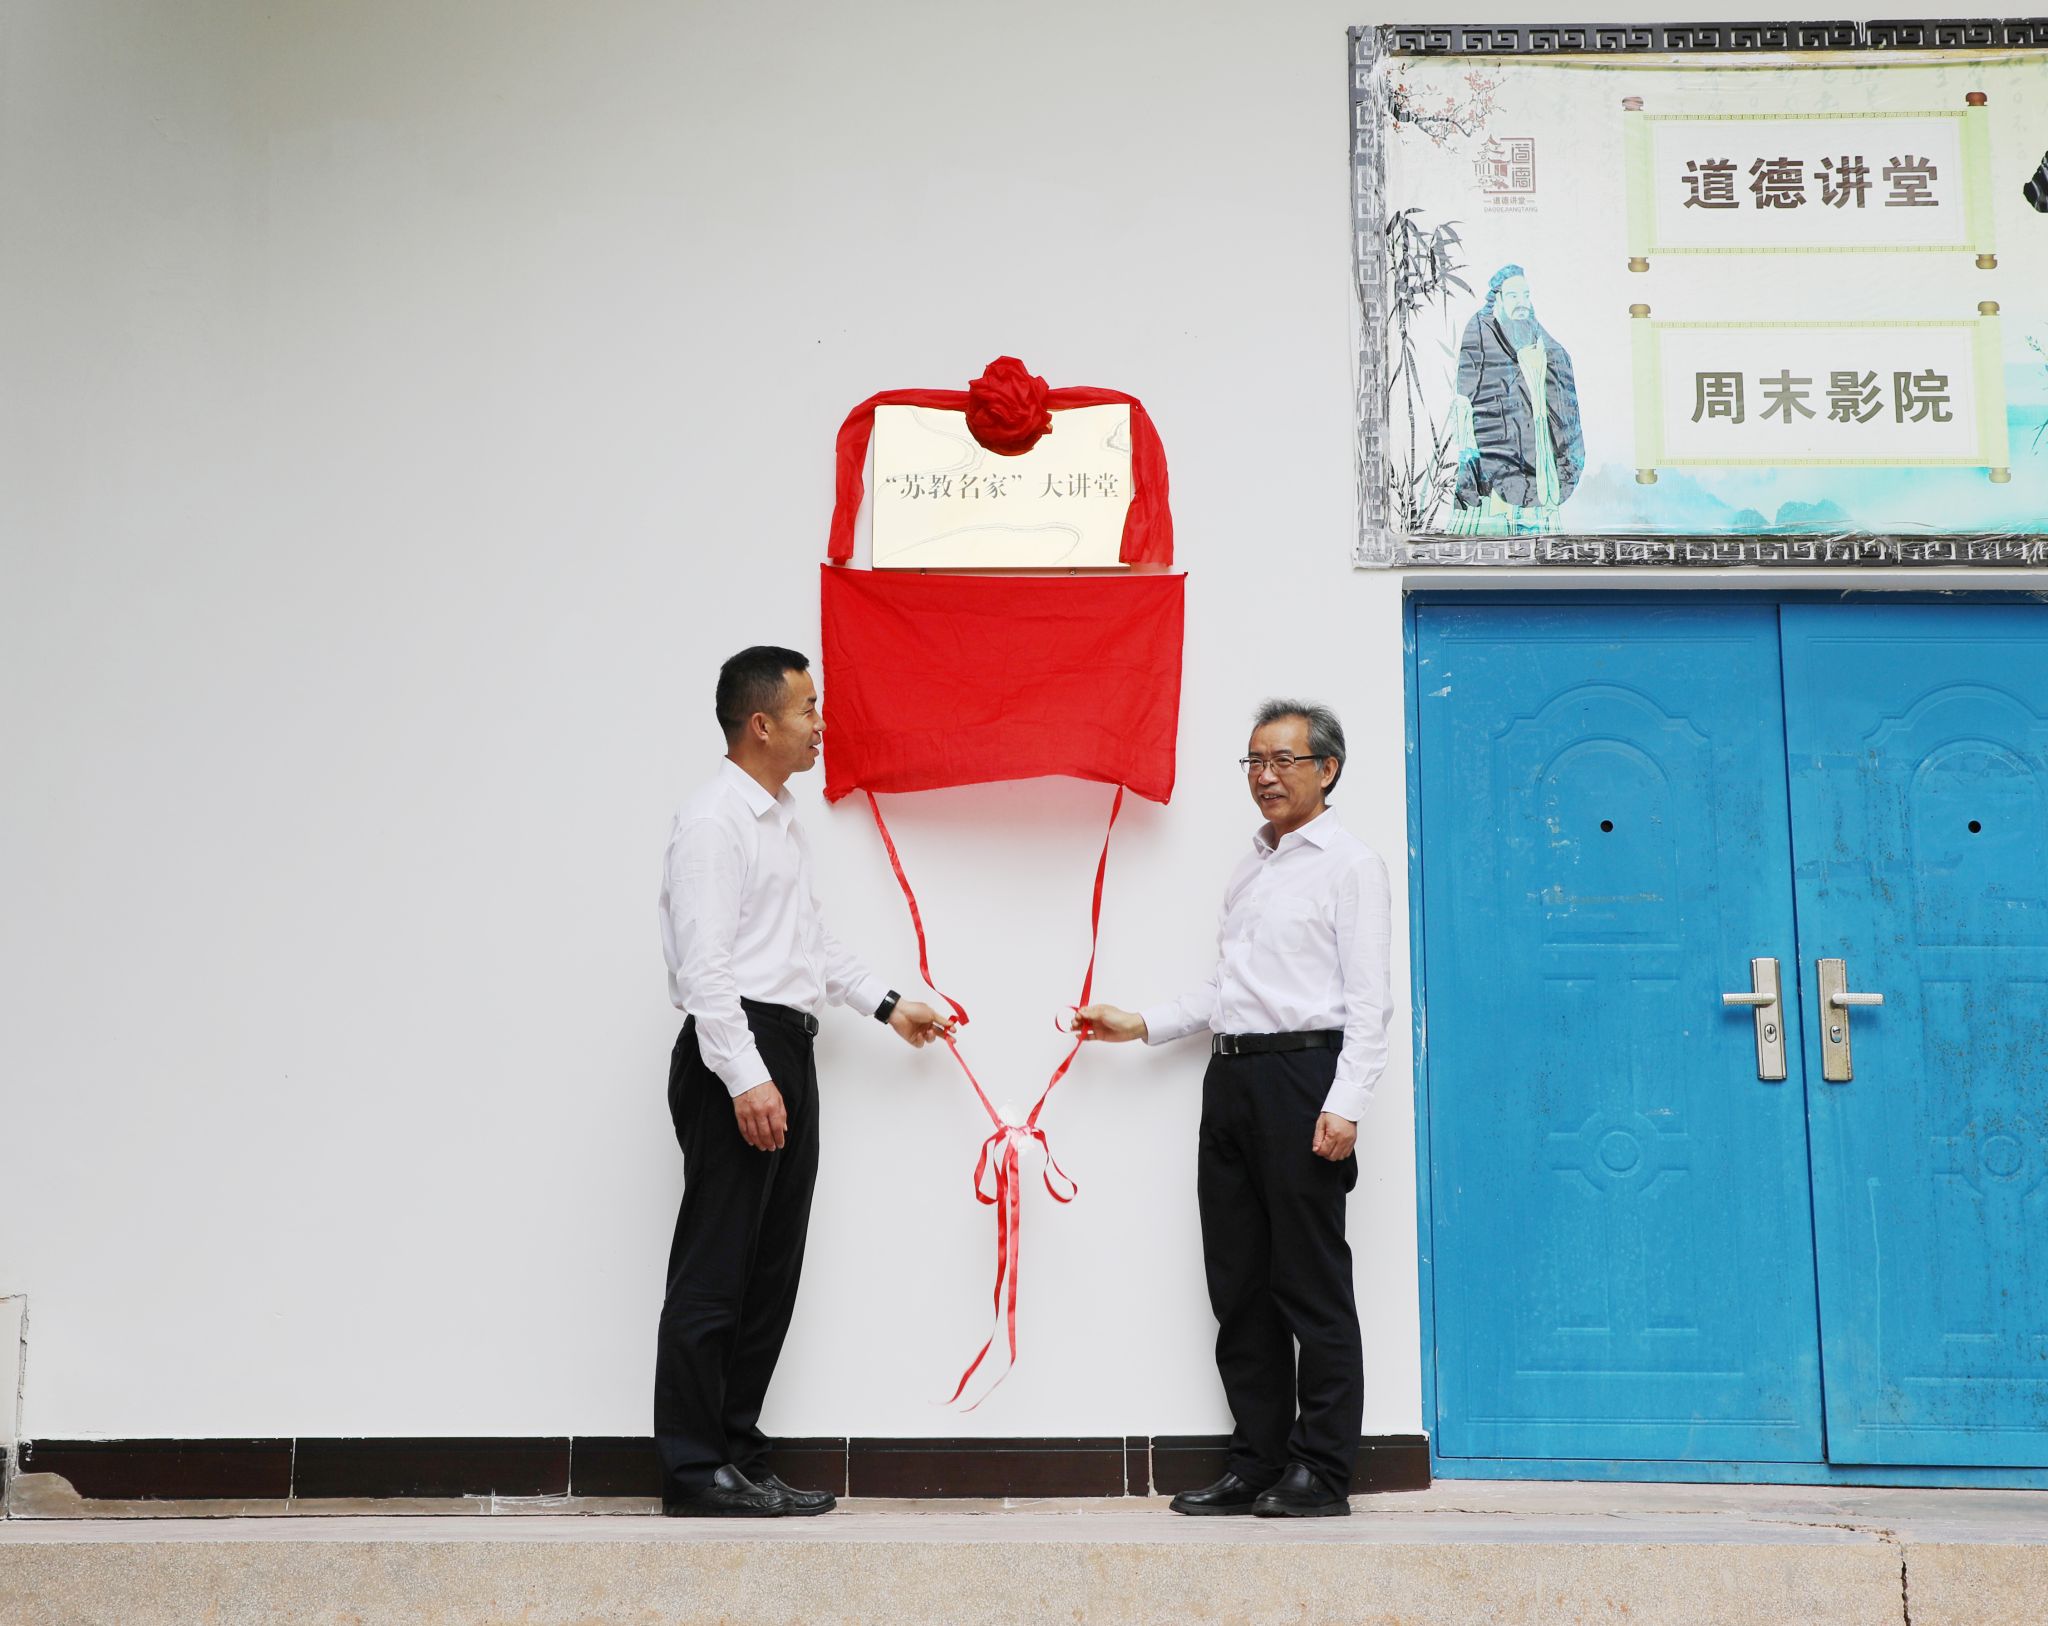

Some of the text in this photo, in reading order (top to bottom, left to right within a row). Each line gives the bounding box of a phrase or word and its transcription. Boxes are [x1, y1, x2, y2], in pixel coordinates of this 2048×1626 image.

[1681, 156, 1940, 210] 道德讲堂
[1691, 369, 1953, 425] 周末影院
